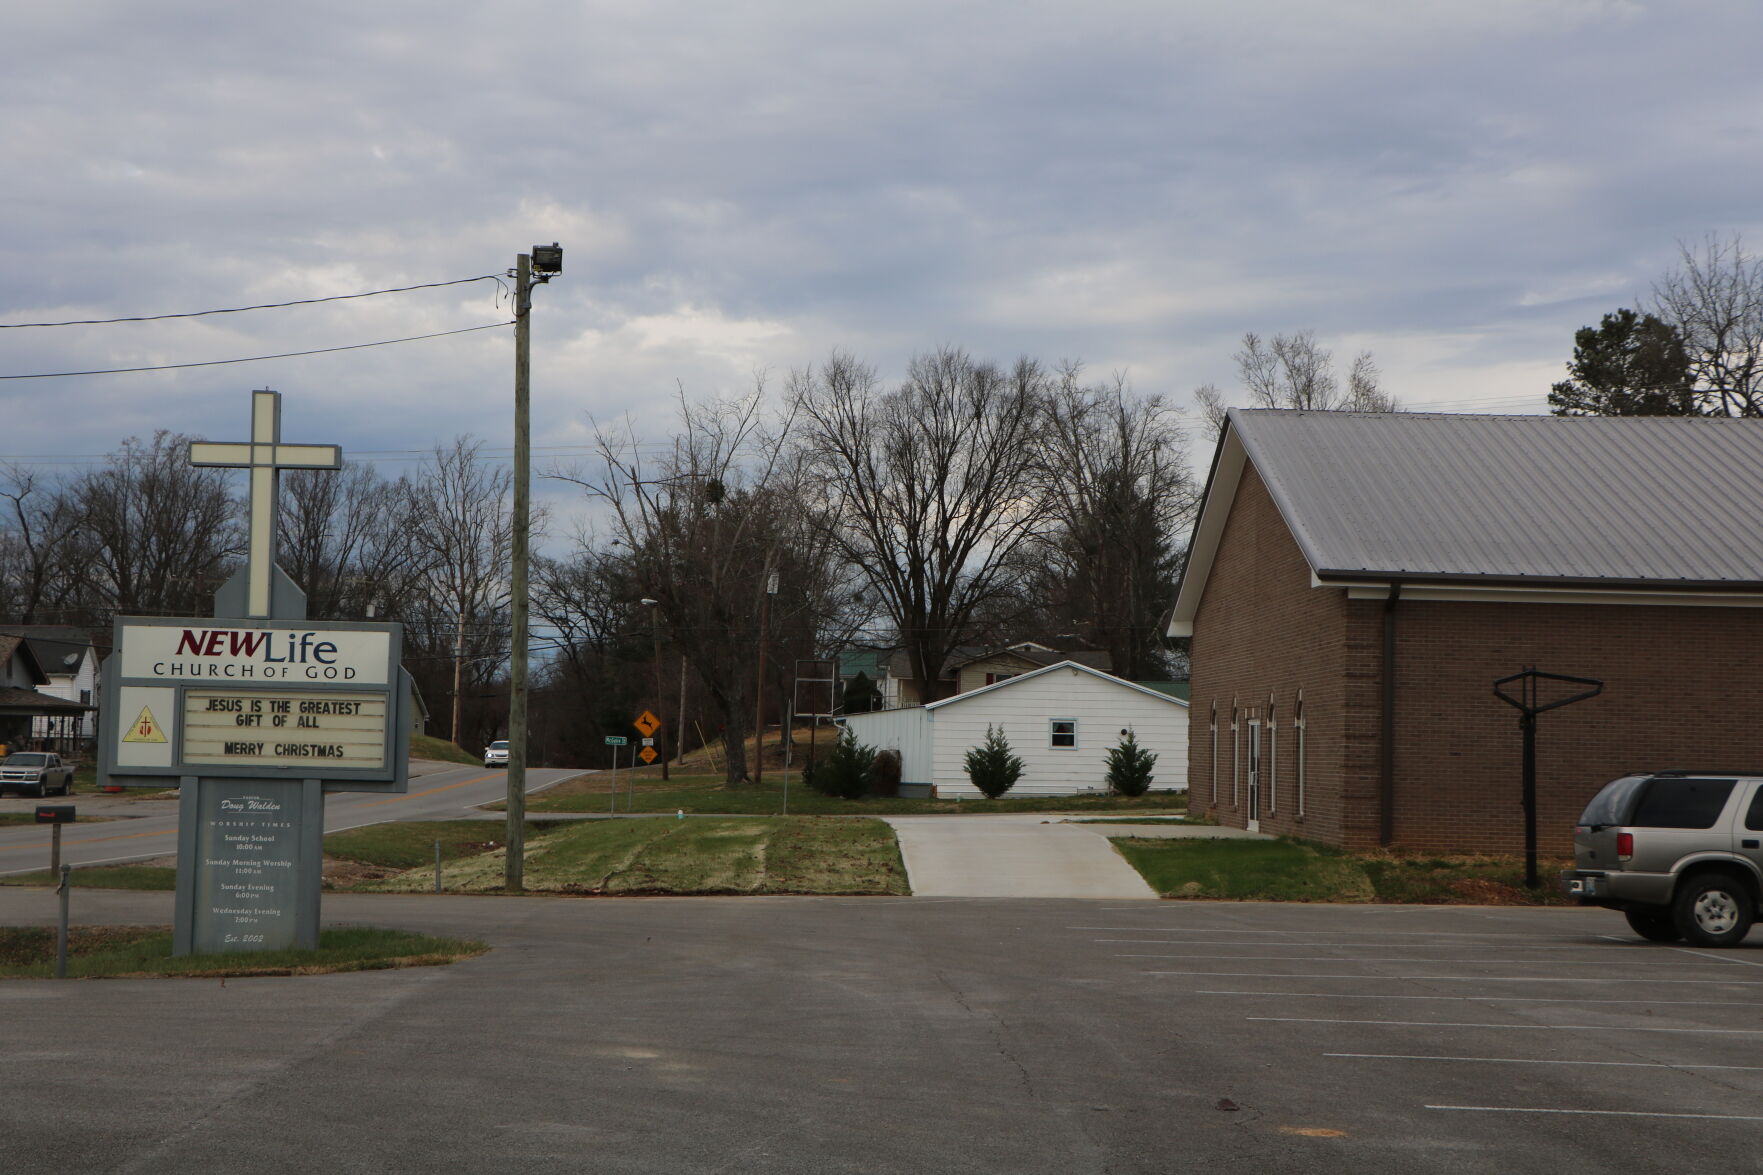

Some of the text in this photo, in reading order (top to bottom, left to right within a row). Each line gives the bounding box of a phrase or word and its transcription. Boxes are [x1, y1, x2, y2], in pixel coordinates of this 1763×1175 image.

[154, 663, 356, 679] CHURCH OF GOD
[205, 700, 361, 715] JESUS IS THE GREATEST
[236, 714, 319, 728] GIFT OF ALL
[224, 742, 344, 758] MERRY CHRISTMAS
[221, 800, 280, 811] Doug Walden
